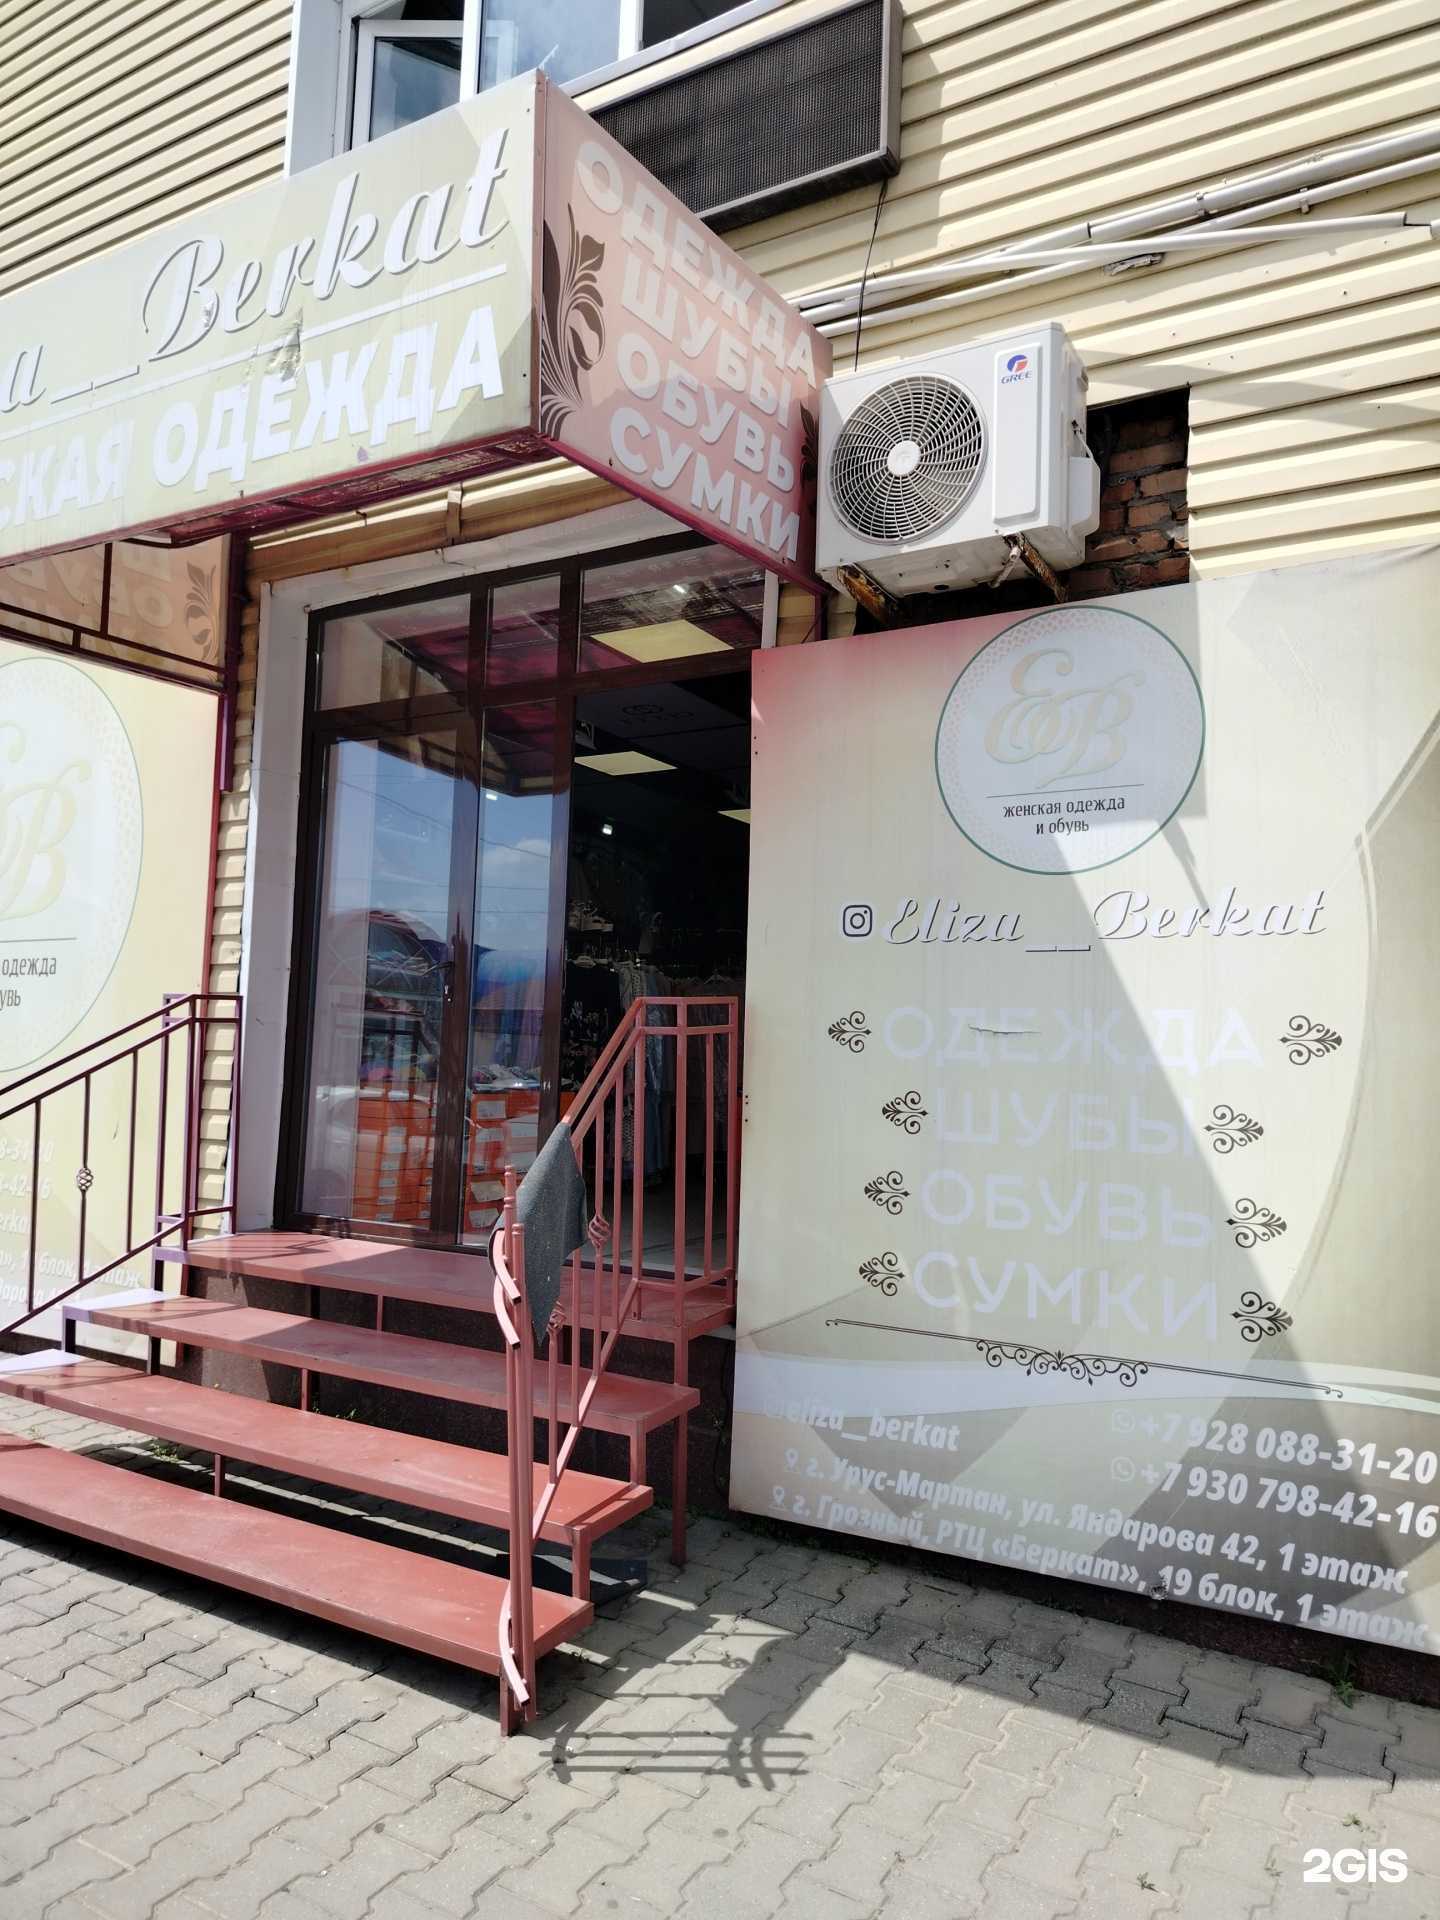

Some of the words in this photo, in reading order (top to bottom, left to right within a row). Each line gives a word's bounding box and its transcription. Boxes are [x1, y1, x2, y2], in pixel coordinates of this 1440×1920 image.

[576, 140, 818, 389] ОДЕЖДА
[620, 255, 792, 431] ШУБЫ
[152, 305, 505, 496] ОДЕЖДА
[615, 332, 796, 493] ОБУВЬ
[609, 406, 800, 564] СУМКИ
[1003, 801, 1061, 818] женская
[1066, 797, 1126, 814] одежда
[1036, 822, 1044, 835] и
[1049, 818, 1090, 837] обувь
[2, 957, 57, 978] одежда
[882, 1006, 1265, 1076] ОДЕЖДА
[934, 1085, 1201, 1160] ШУБЫ
[920, 1168, 1215, 1248] ОБУВЬ
[914, 1250, 1218, 1343] СУМКИ
[1136, 1413, 1185, 1443] +7
[1189, 1420, 1249, 1455] 928
[1255, 1427, 1438, 1485] 088-31-20
[830, 1456, 1012, 1521] Урус-Мартан,
[1018, 1499, 1060, 1528] ул.
[1069, 1503, 1215, 1556] Яндарова
[1220, 1532, 1267, 1572] 42,
[1279, 1542, 1296, 1572] 1
[1301, 1552, 1409, 1594] этаж
[1141, 1462, 1183, 1493] +7
[1186, 1466, 1249, 1505] 930
[1255, 1477, 1440, 1538] 798-42-16
[816, 1494, 929, 1545] Грозный,
[937, 1520, 985, 1562] РТЦ
[1158, 1565, 1193, 1597] 19
[1199, 1572, 1284, 1622] блок,
[1297, 1593, 1314, 1624] 1
[1320, 1603, 1430, 1648] этаж
